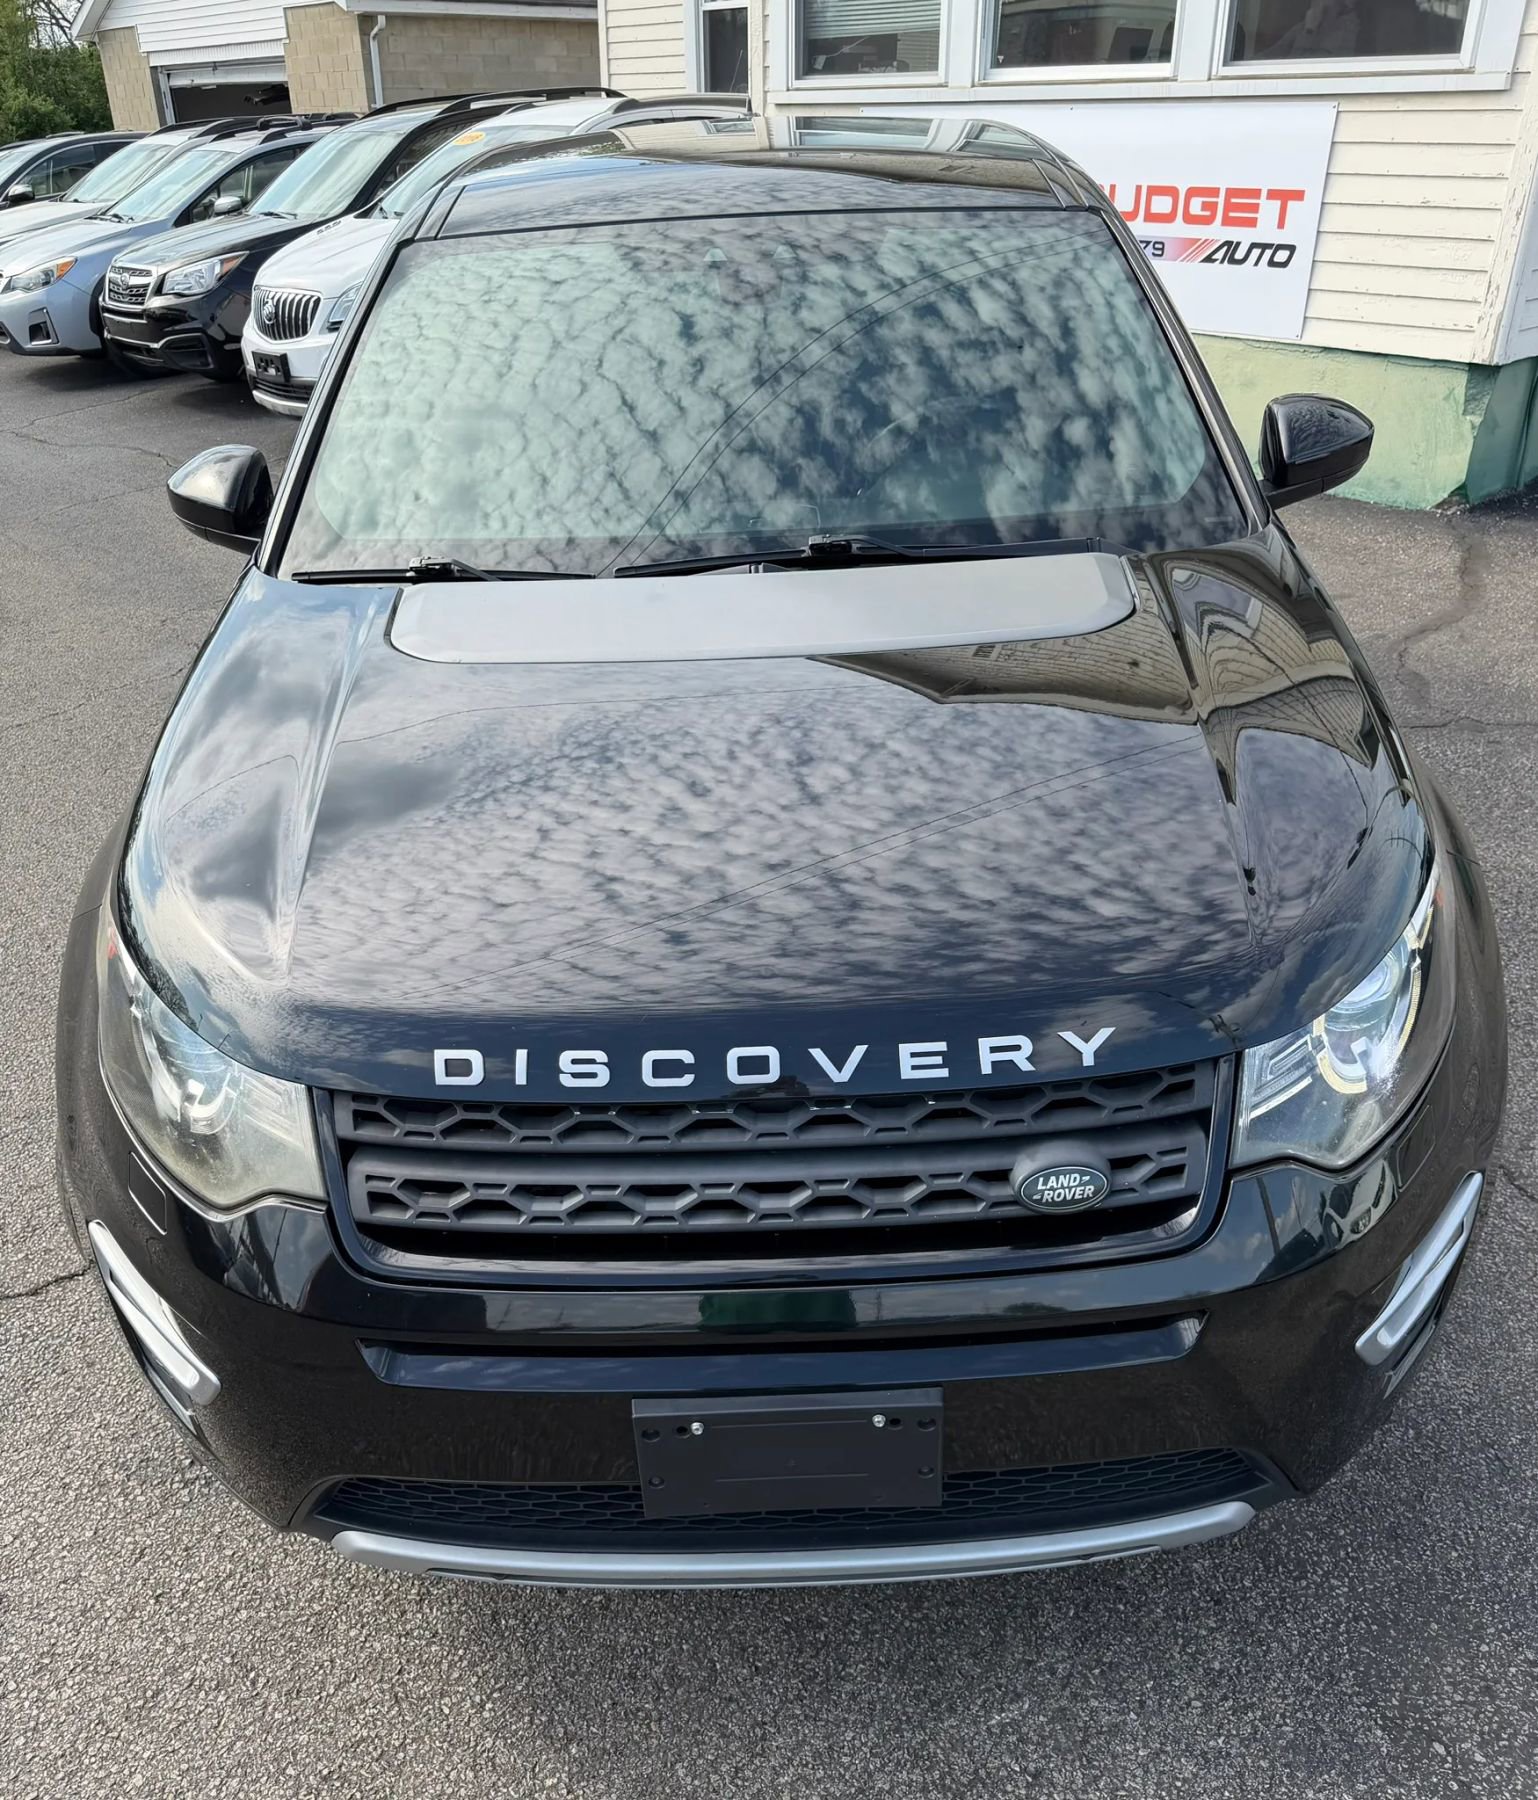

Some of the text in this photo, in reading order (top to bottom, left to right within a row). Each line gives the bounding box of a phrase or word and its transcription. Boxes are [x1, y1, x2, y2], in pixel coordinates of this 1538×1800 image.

[1099, 184, 1305, 230] UDGET
[1200, 241, 1297, 268] AUTO
[434, 1027, 1116, 1087] DISCOVERY
[1041, 1185, 1095, 1203] ROVER
